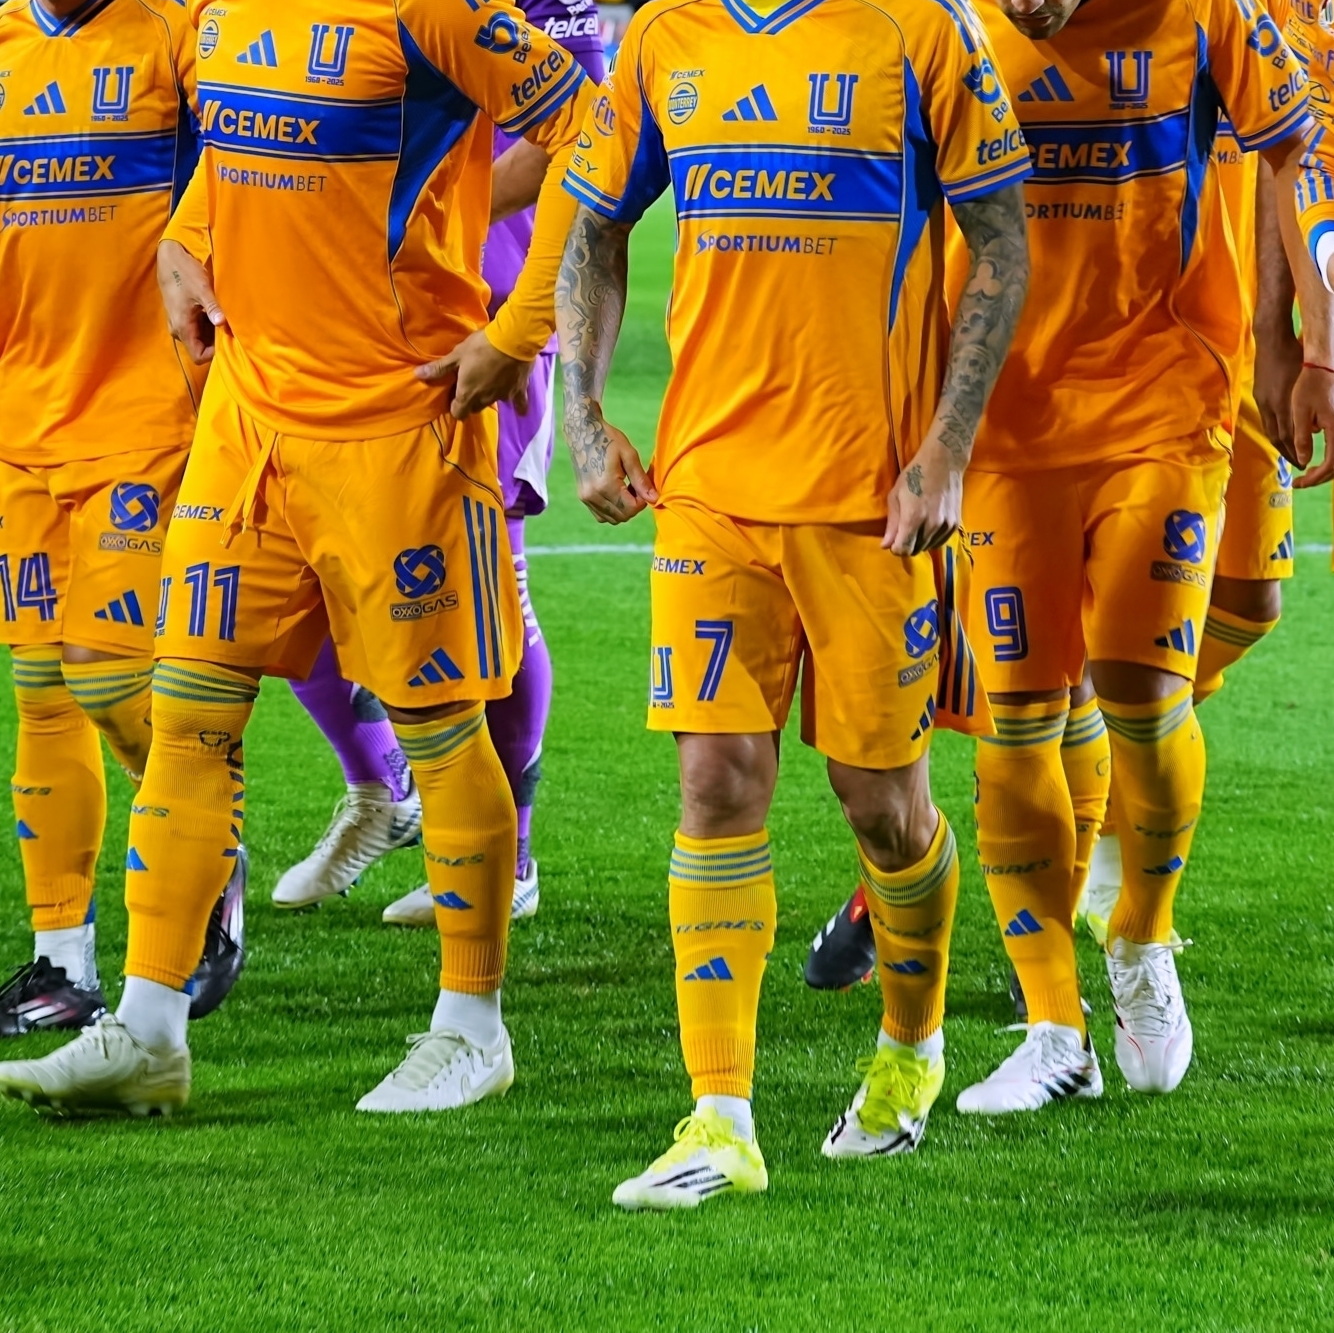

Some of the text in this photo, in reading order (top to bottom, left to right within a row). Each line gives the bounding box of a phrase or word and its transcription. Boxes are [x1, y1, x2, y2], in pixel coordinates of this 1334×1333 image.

[544, 14, 599, 39] telcel
[311, 24, 355, 78] U
[93, 67, 134, 114] U
[511, 44, 565, 107] telcel
[677, 69, 705, 79] CEMEX
[1105, 51, 1153, 102] U
[808, 73, 859, 126] U
[218, 108, 321, 145] CEMEX
[832, 127, 851, 136] 2025
[13, 155, 115, 184] CEMEX
[709, 169, 836, 201] CEMEX
[695, 228, 838, 255] SPORTIUMBET
[173, 504, 224, 522] CEMEX
[127, 536, 161, 554] GAS
[184, 561, 241, 642] 11
[393, 592, 457, 618] OXXO GAS
[984, 586, 1029, 661] 9
[695, 619, 734, 701] 7
